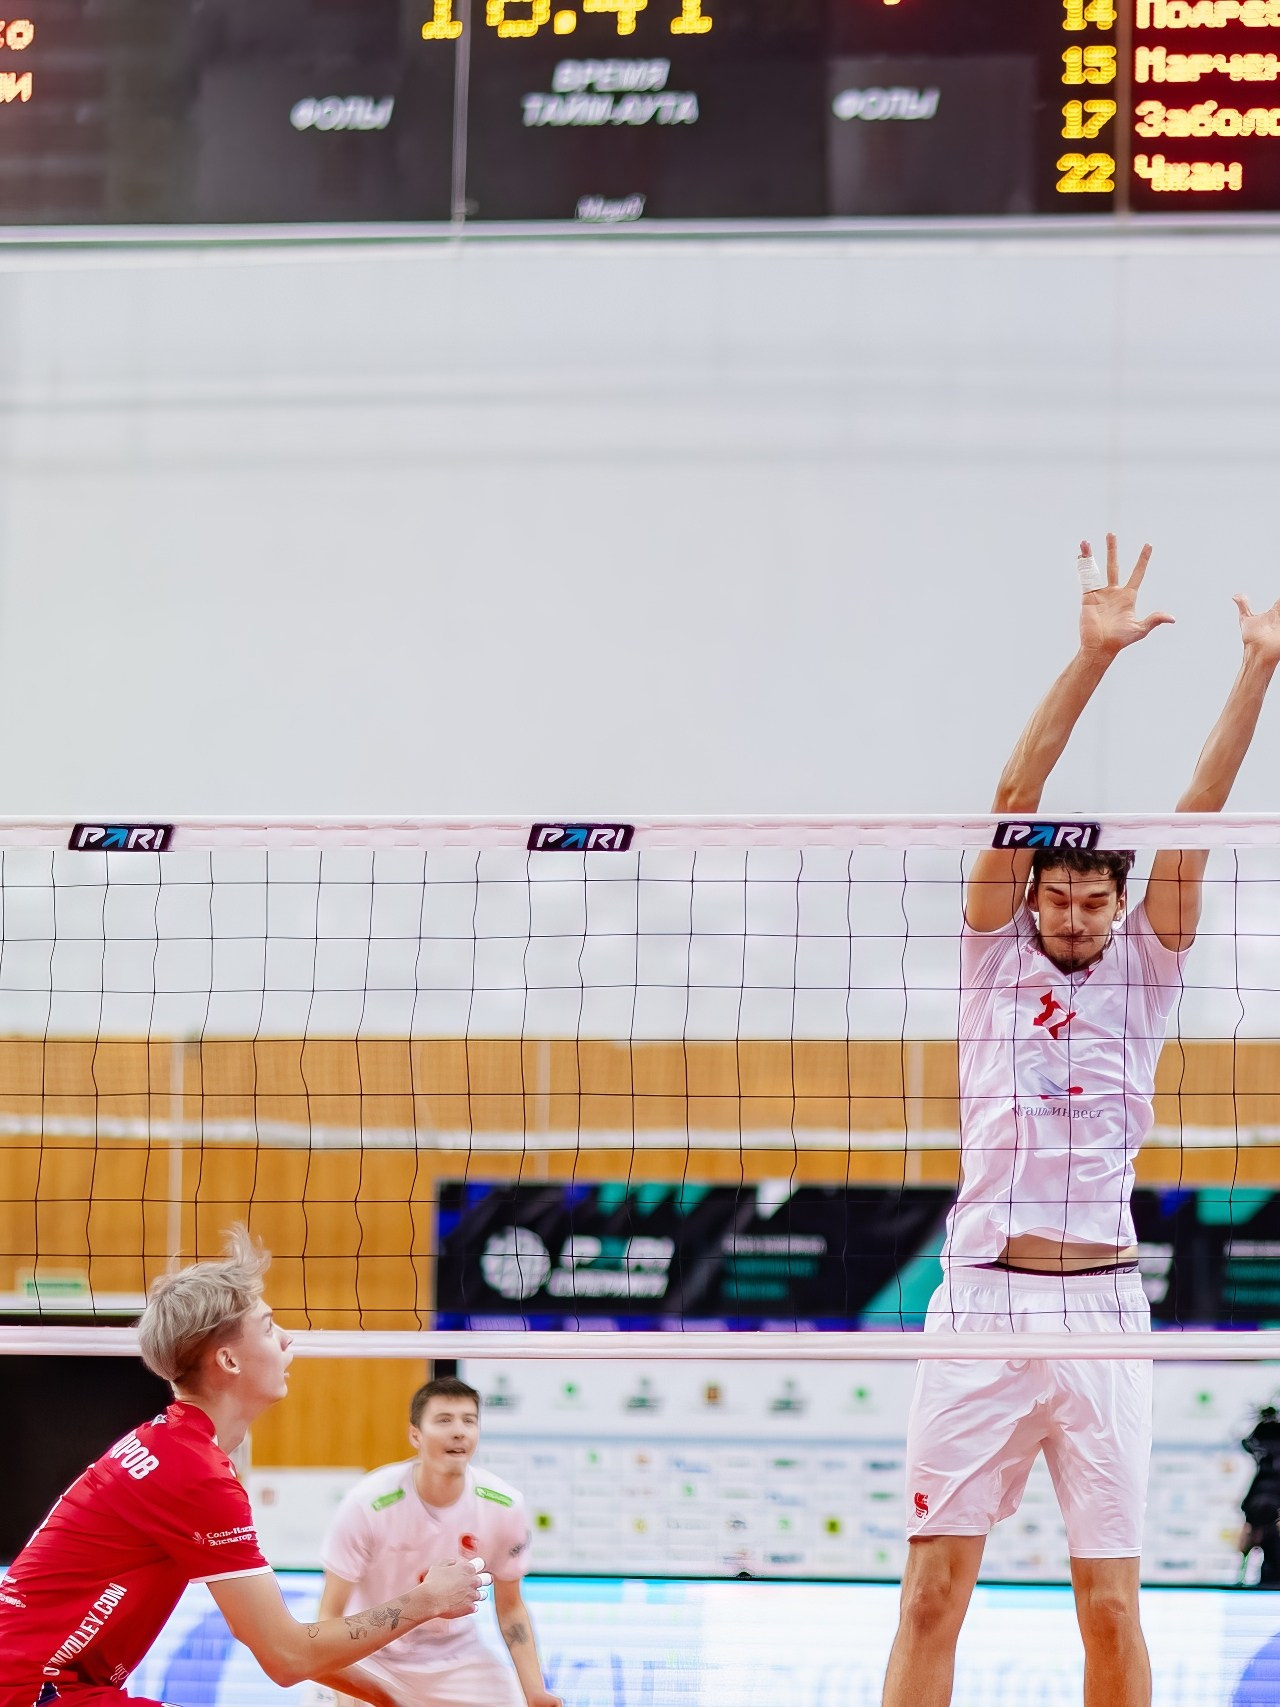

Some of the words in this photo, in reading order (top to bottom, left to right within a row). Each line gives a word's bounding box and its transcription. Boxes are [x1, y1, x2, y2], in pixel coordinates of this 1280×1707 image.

[1061, 0, 1118, 31] 14
[1061, 46, 1118, 85] 15
[1061, 100, 1118, 139] 17
[1056, 153, 1116, 192] 22
[77, 827, 165, 849] PARI
[536, 828, 625, 849] PARI
[1002, 825, 1092, 848] PARI
